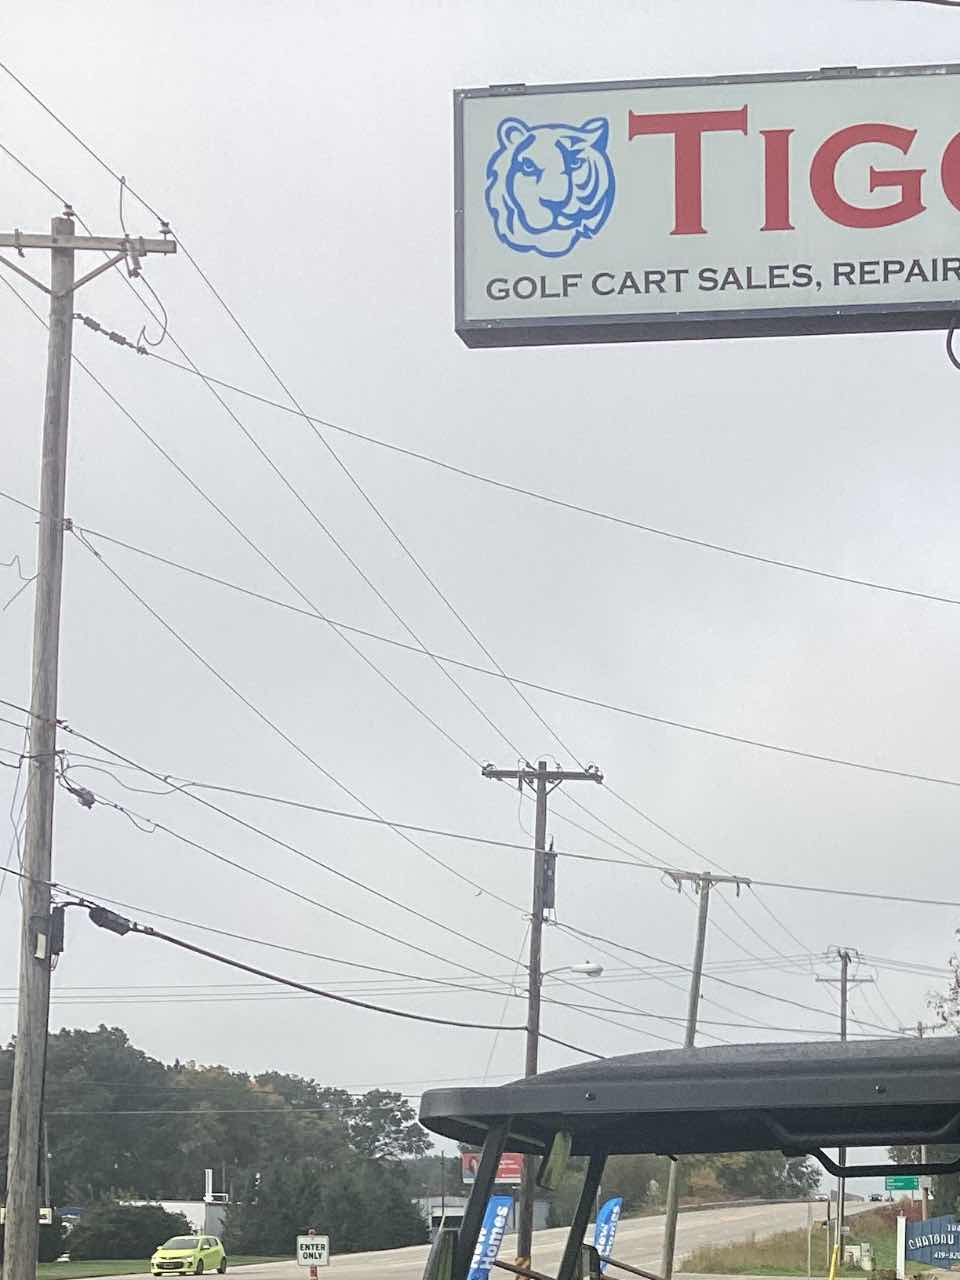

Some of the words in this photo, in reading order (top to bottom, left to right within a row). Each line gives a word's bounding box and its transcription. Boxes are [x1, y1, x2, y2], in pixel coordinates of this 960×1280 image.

[486, 273, 583, 301] GOLF
[591, 268, 690, 296] CART
[698, 262, 822, 292] SALES,
[300, 1243, 326, 1251] ENTER
[302, 1252, 322, 1260] ONLY
